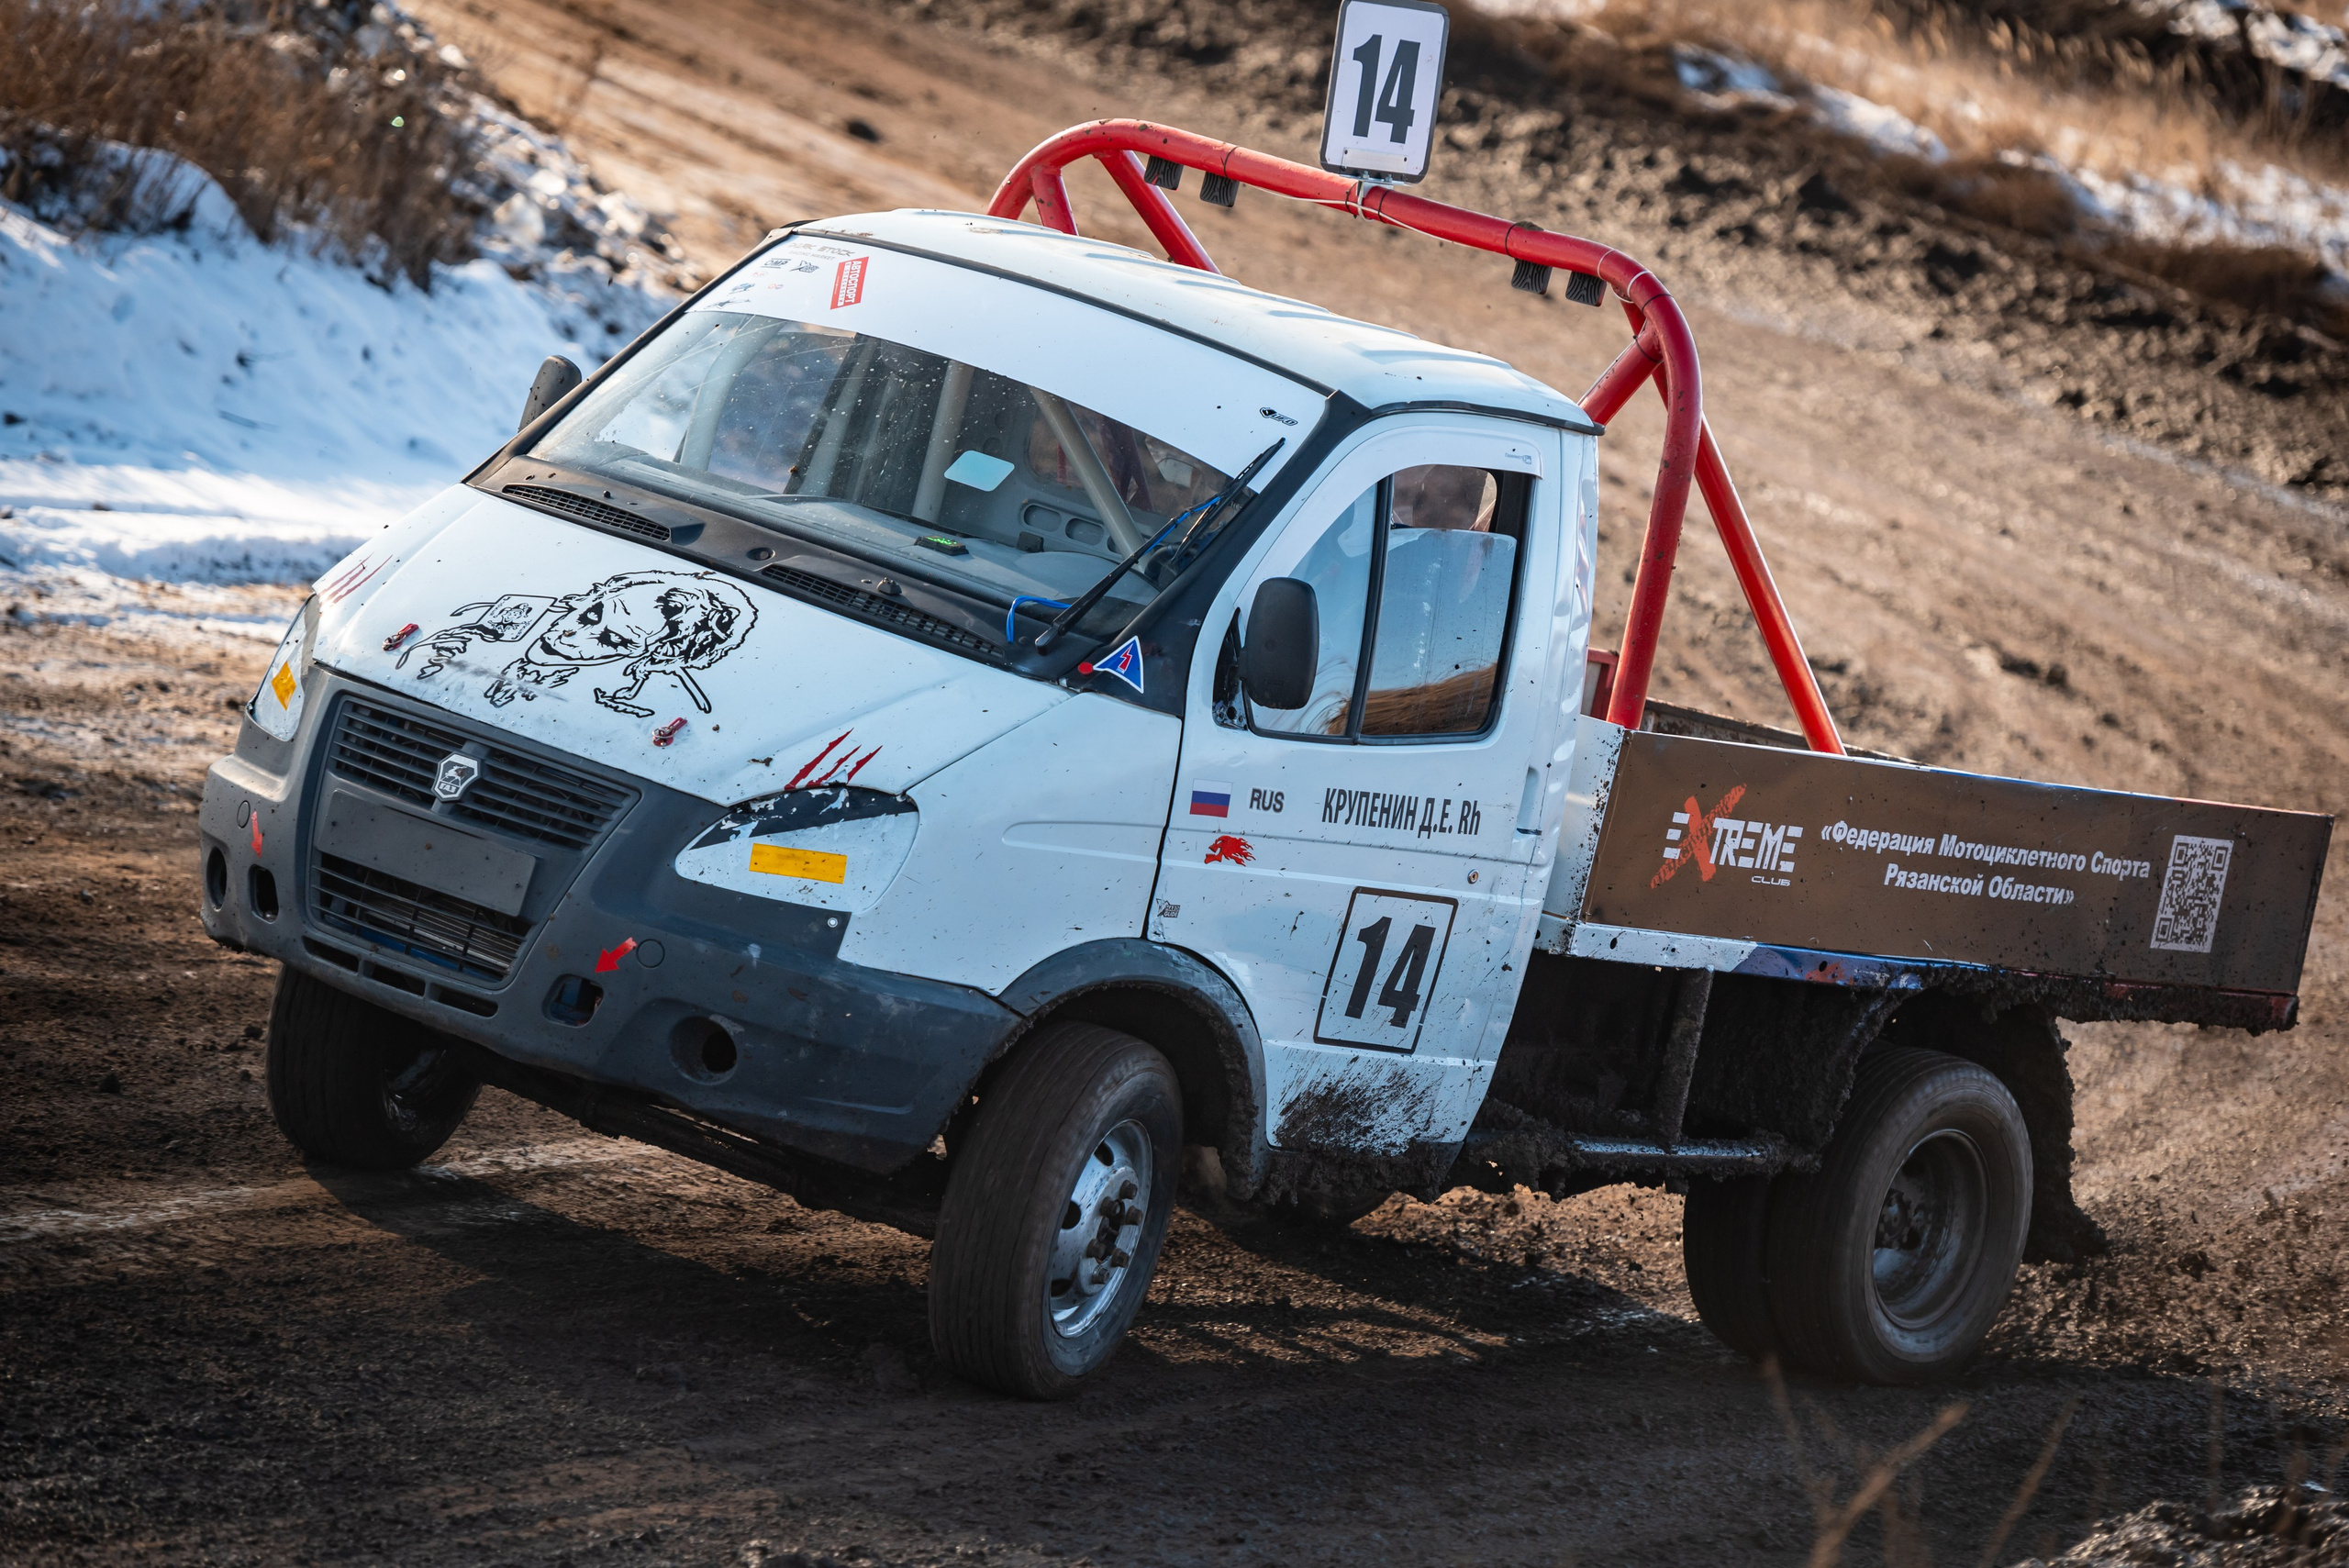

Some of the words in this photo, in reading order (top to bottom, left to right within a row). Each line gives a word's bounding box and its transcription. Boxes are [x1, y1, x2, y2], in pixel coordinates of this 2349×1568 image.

[1353, 34, 1420, 144] 14
[764, 259, 789, 267] OMP
[844, 261, 863, 304] АВТОСПОРТ
[439, 783, 457, 794] ГАЗ
[1249, 787, 1286, 814] RUS
[1321, 787, 1419, 831] КРУПЕНИН
[1417, 797, 1453, 840] Д.Е.
[1457, 800, 1481, 836] Rh
[1653, 786, 1804, 886] EXTREME
[1820, 820, 1936, 857] «Федерация
[1938, 833, 2087, 873] Мотоциклетного
[2090, 851, 2151, 882] Спорта
[1751, 875, 1791, 887] CLUB
[1884, 862, 1985, 896] Рязанской
[1987, 875, 2075, 905] Области»
[1344, 916, 1437, 1029] 14
